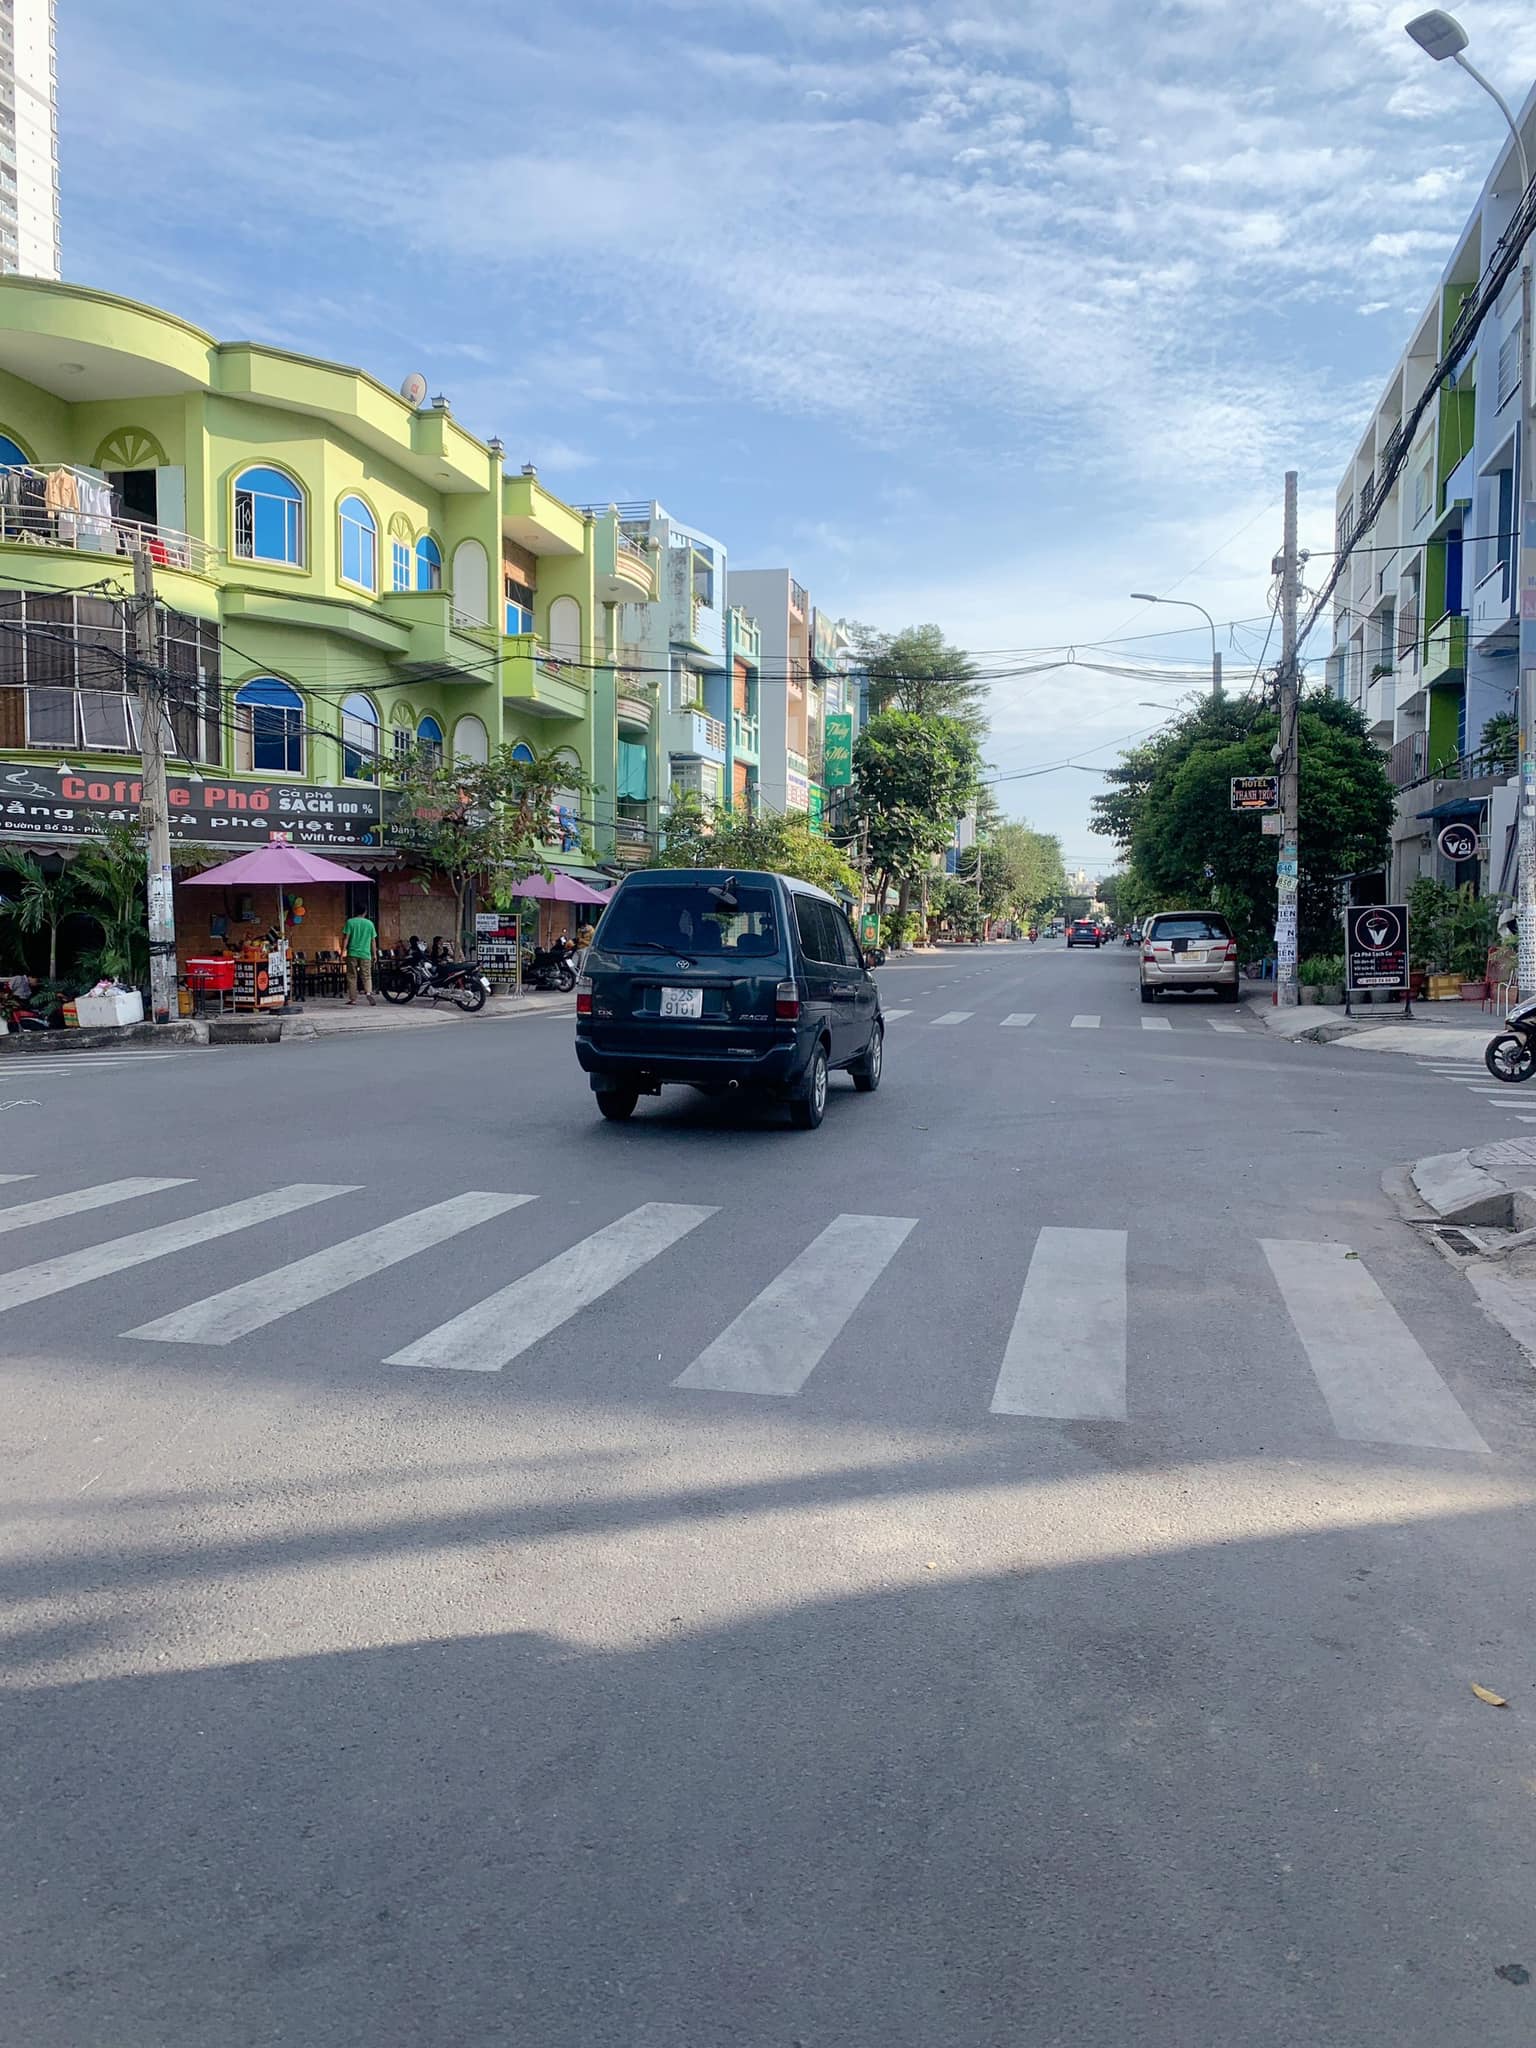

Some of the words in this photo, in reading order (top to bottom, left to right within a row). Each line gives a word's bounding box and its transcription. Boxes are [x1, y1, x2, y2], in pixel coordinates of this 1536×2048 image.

[1242, 780, 1268, 788] HOTEL
[62, 776, 191, 806] Coffe
[204, 787, 273, 811] Phố
[305, 791, 333, 800] phê
[279, 799, 334, 814] SẠCH
[337, 803, 358, 814] 100
[362, 804, 374, 814] %
[62, 825, 75, 833] 32
[211, 817, 269, 829] phê
[280, 820, 335, 832] việt
[300, 832, 326, 842] Wifi
[328, 834, 356, 843] free
